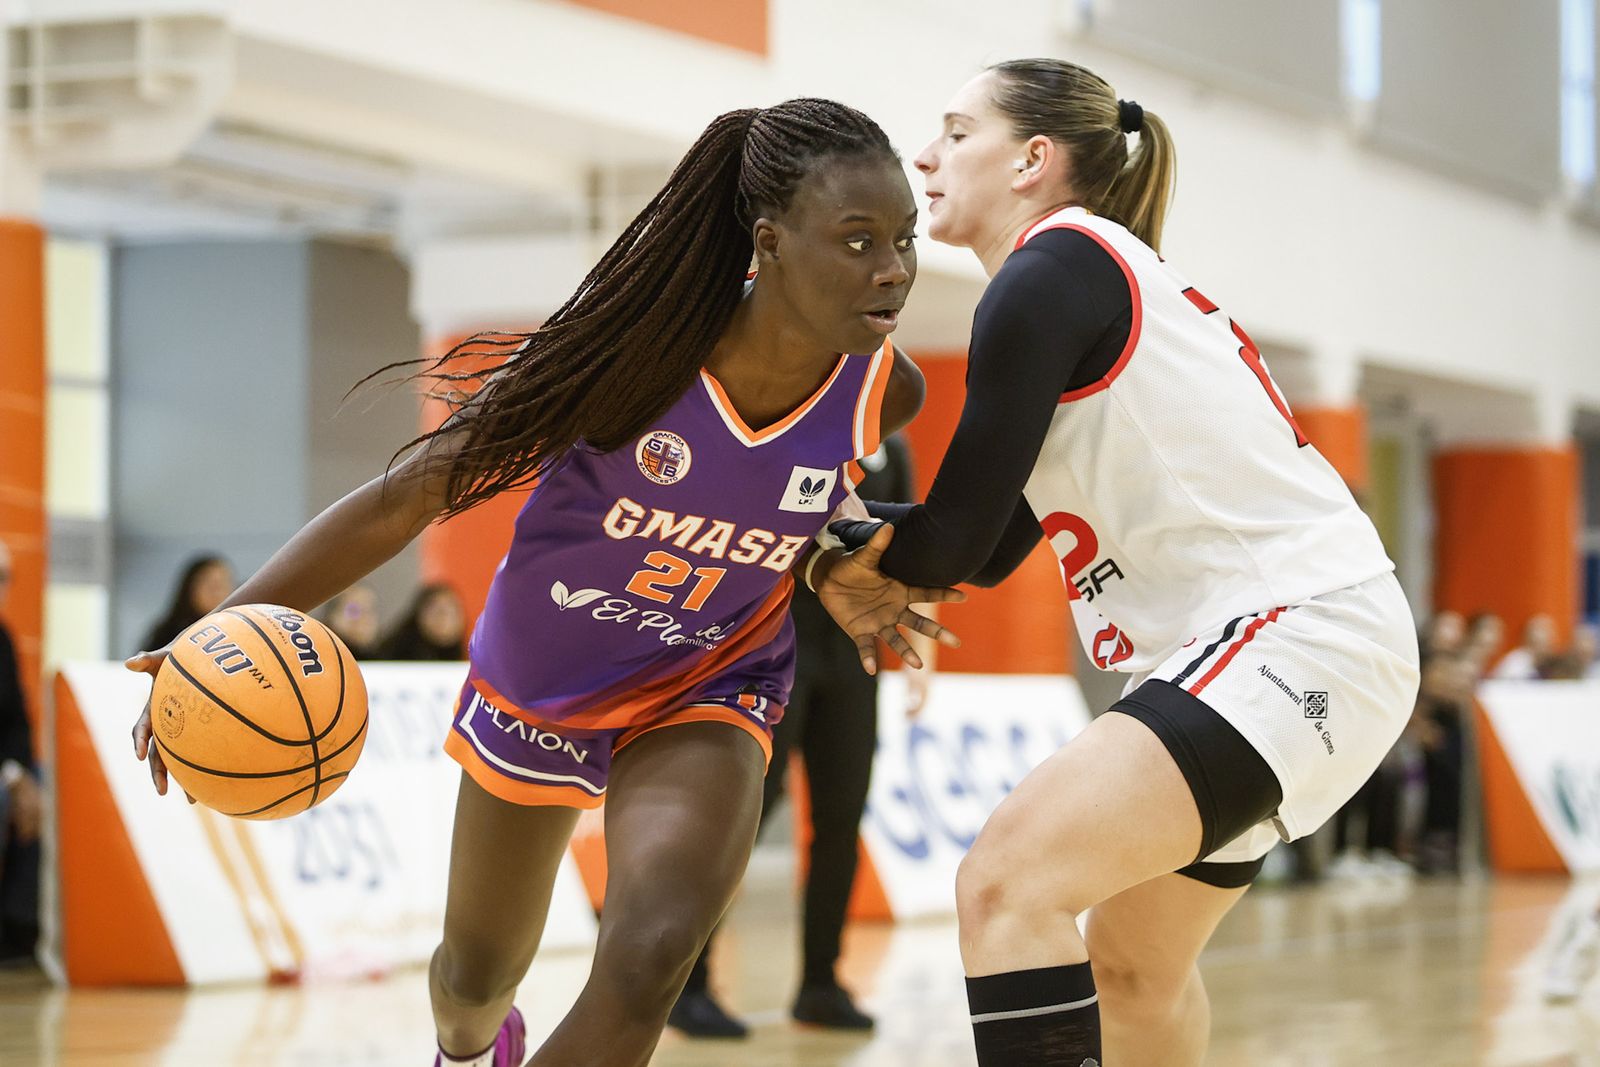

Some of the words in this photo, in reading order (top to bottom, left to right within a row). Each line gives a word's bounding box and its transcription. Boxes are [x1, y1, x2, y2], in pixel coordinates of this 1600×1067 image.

[602, 497, 809, 573] GMASB
[591, 598, 638, 623] El
[625, 550, 728, 612] 21
[188, 622, 254, 676] EVO
[249, 668, 274, 690] NXT
[1257, 664, 1303, 706] Ajuntament
